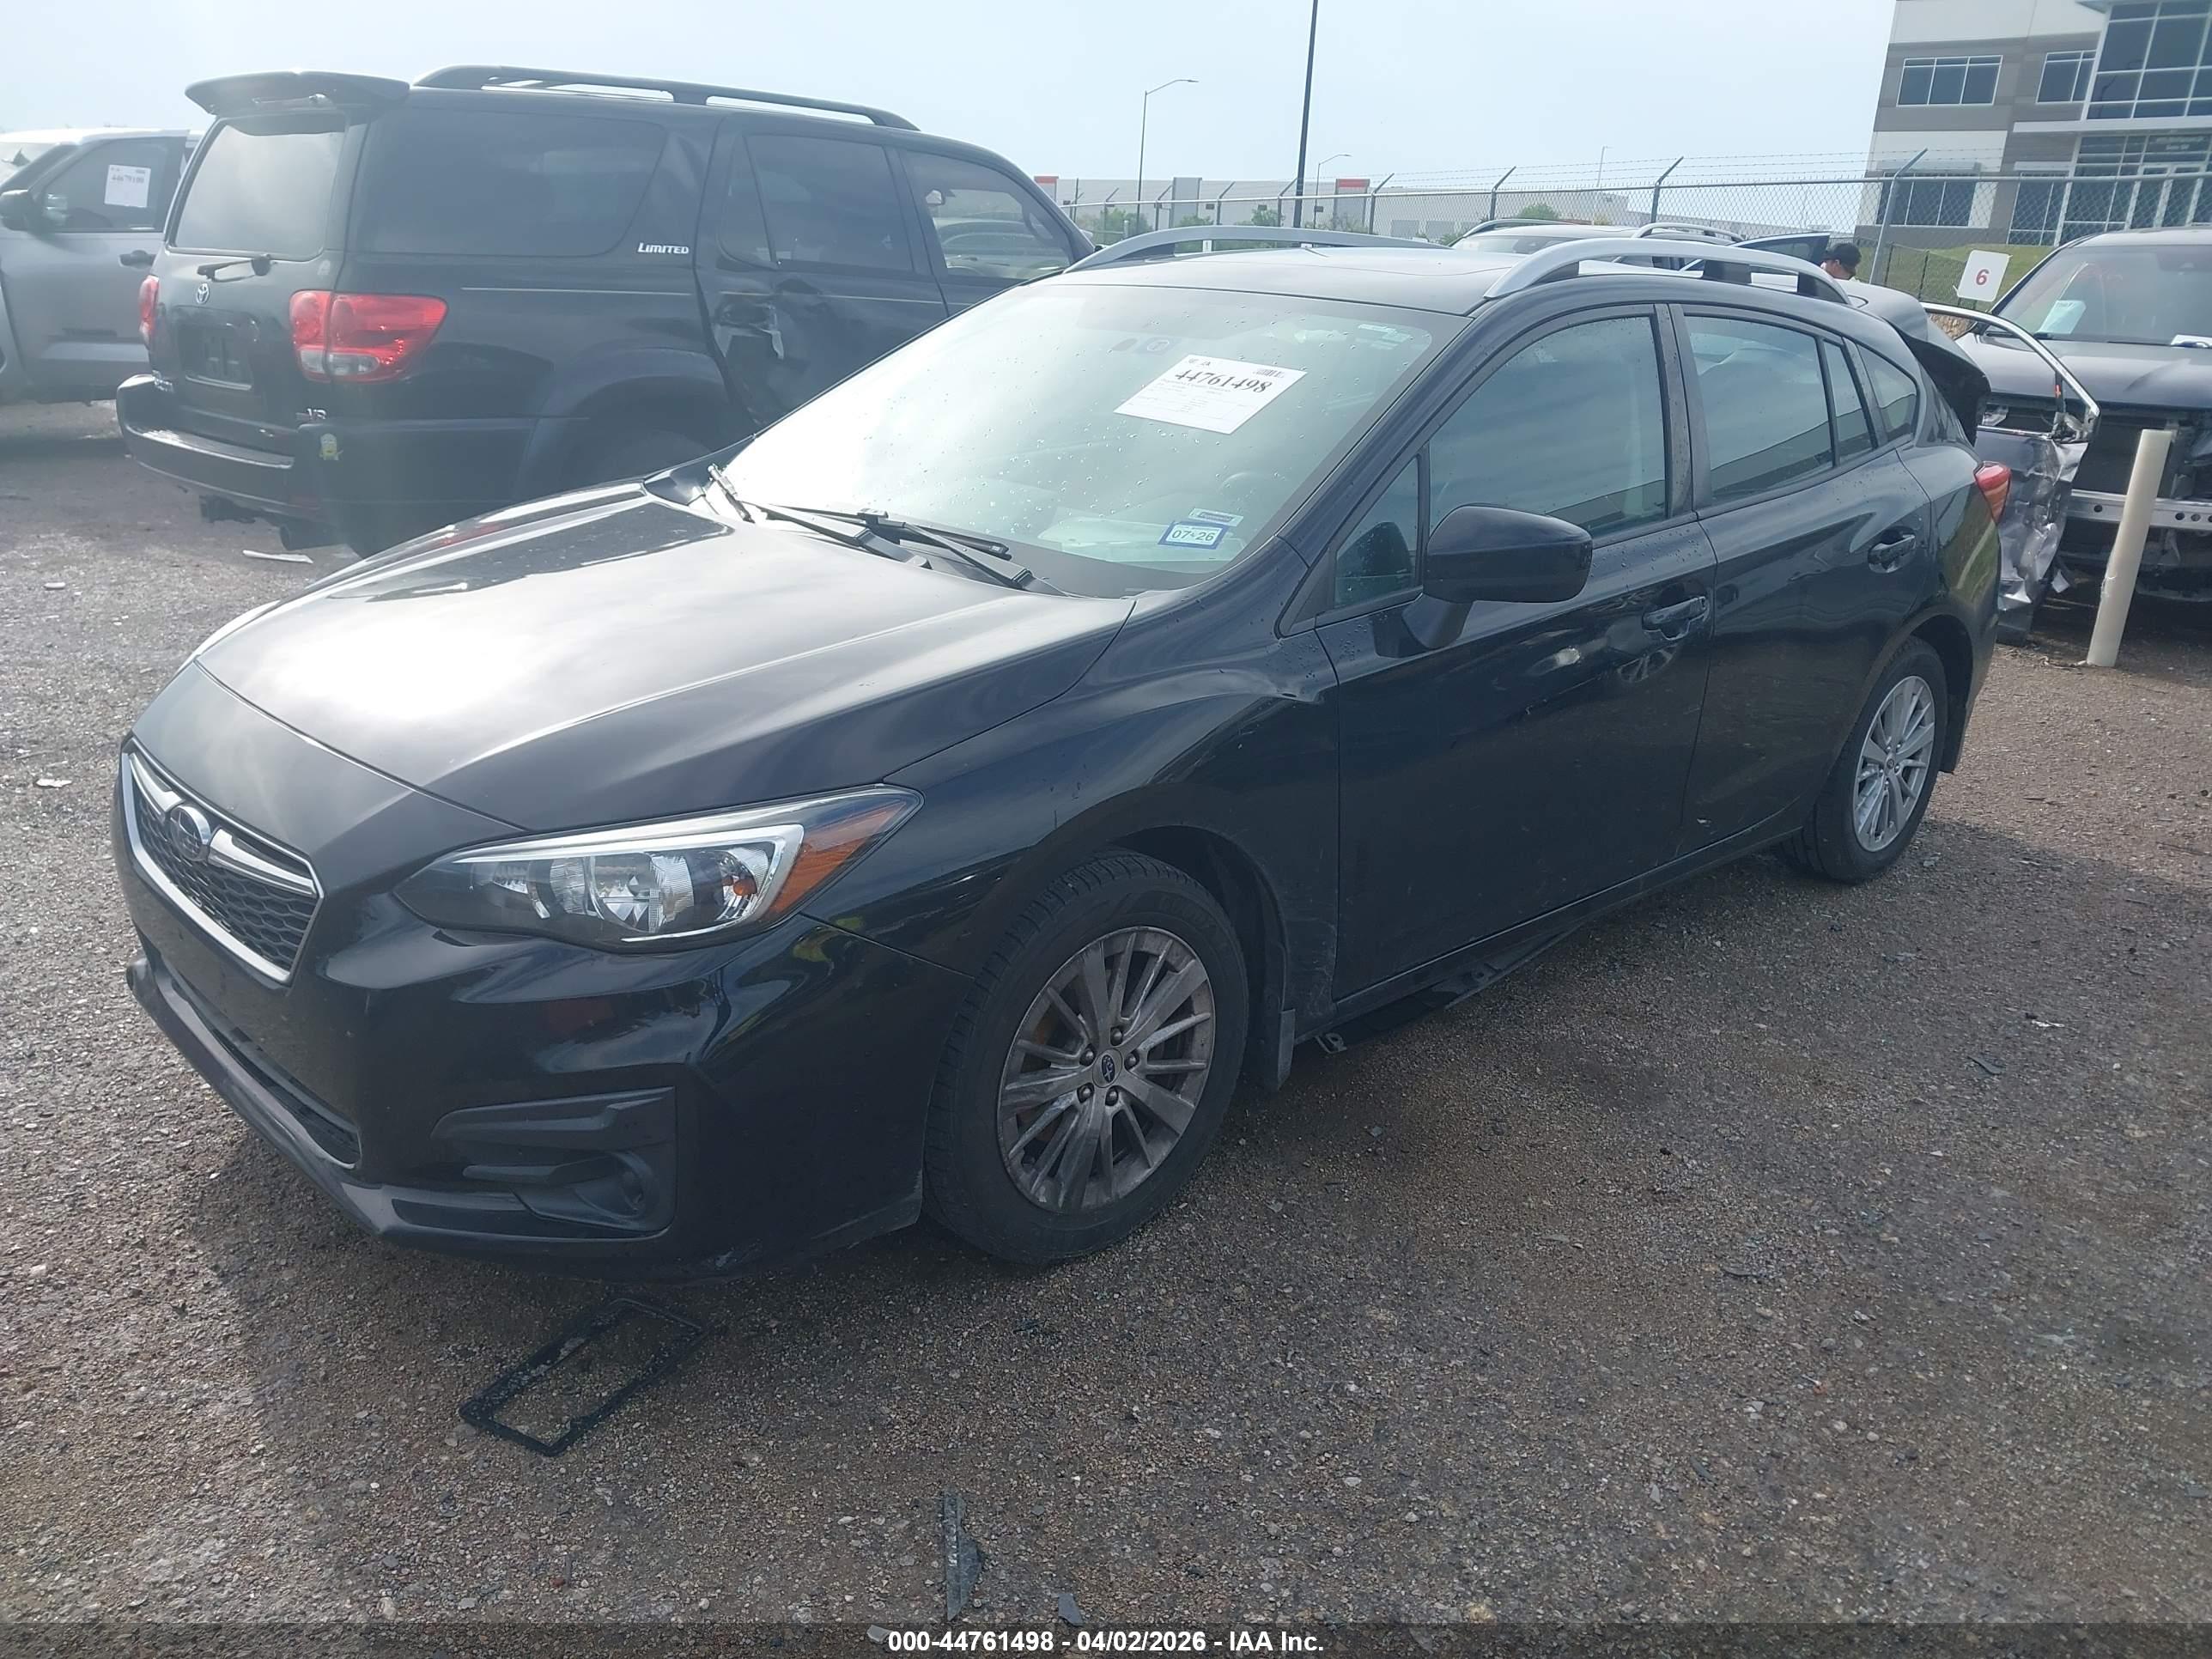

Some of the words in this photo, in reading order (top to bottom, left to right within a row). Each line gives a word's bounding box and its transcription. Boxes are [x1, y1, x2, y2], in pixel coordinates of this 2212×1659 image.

[637, 242, 690, 254] LIMITED
[1976, 269, 1990, 285] 6
[1175, 369, 1273, 392] 44761498
